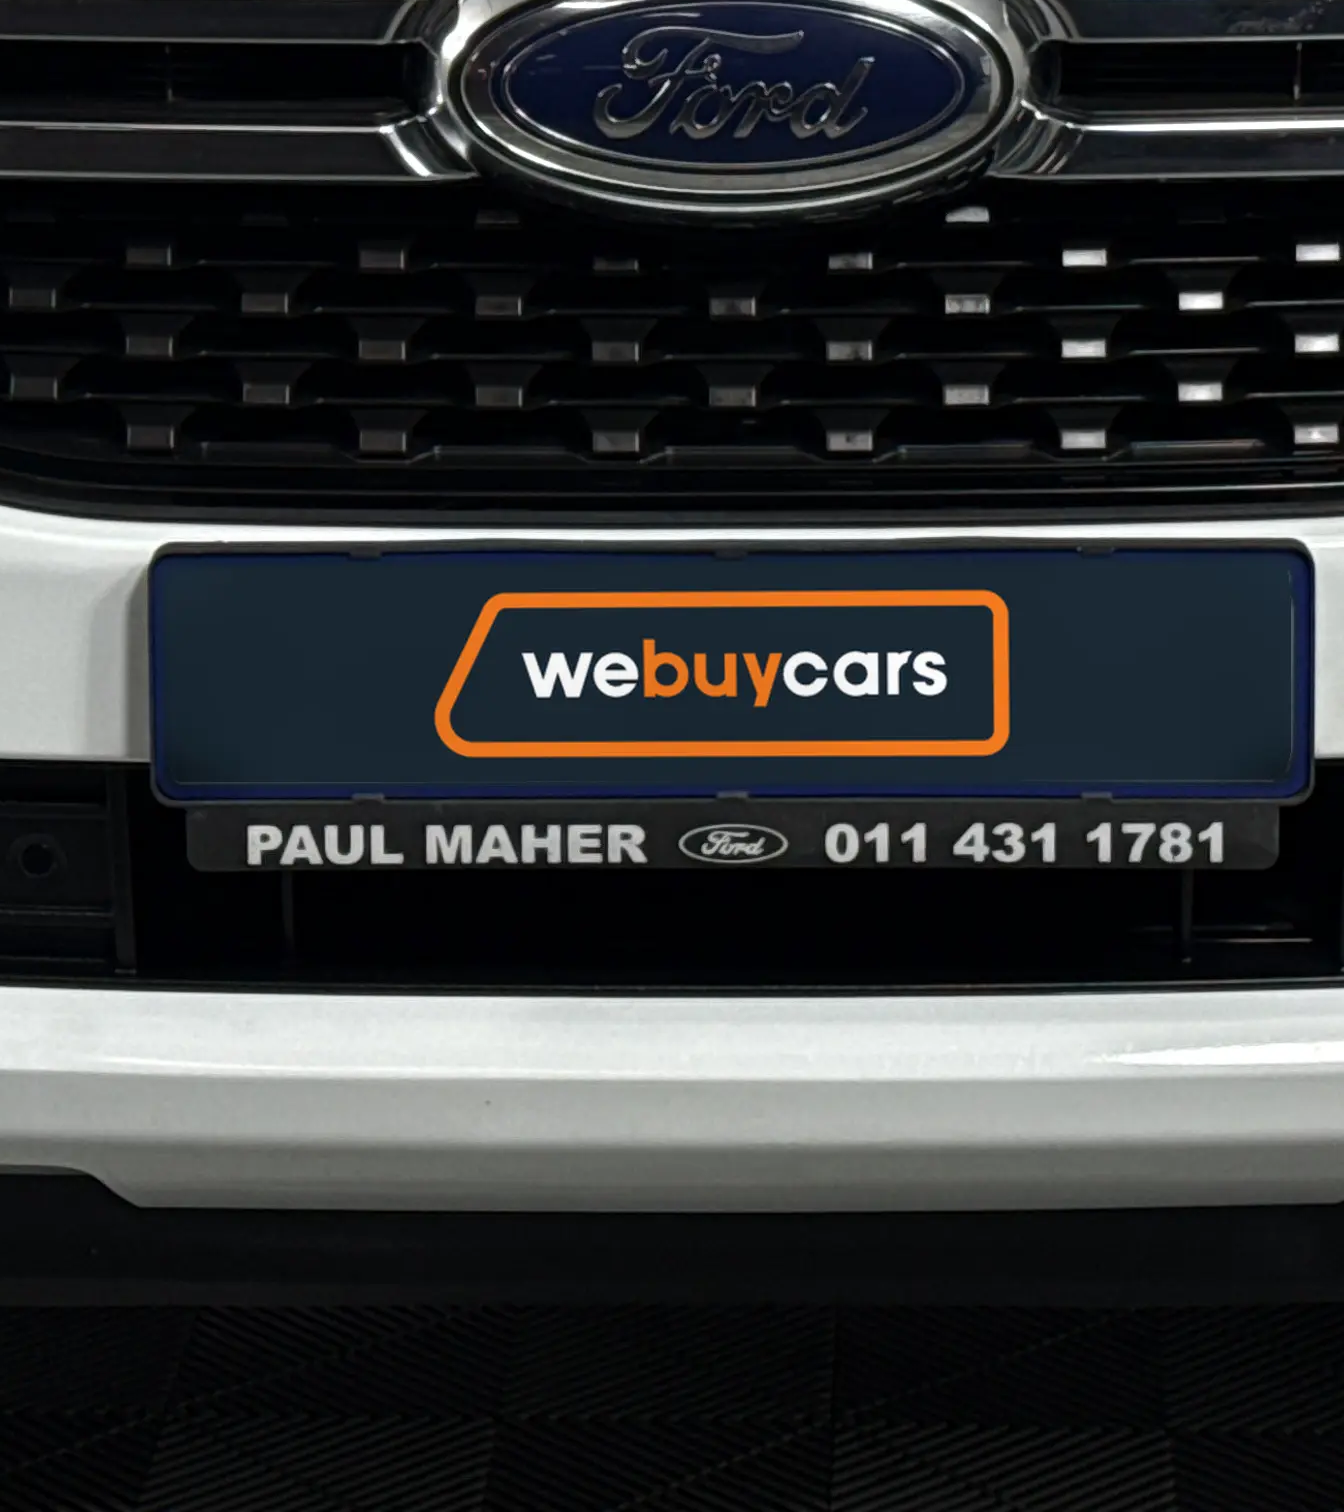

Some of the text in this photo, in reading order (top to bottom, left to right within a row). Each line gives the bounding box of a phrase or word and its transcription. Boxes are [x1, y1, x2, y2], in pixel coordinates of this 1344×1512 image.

[593, 25, 876, 140] Ford
[248, 822, 1224, 865] PAUL MAHER Ford 011 431 1781
